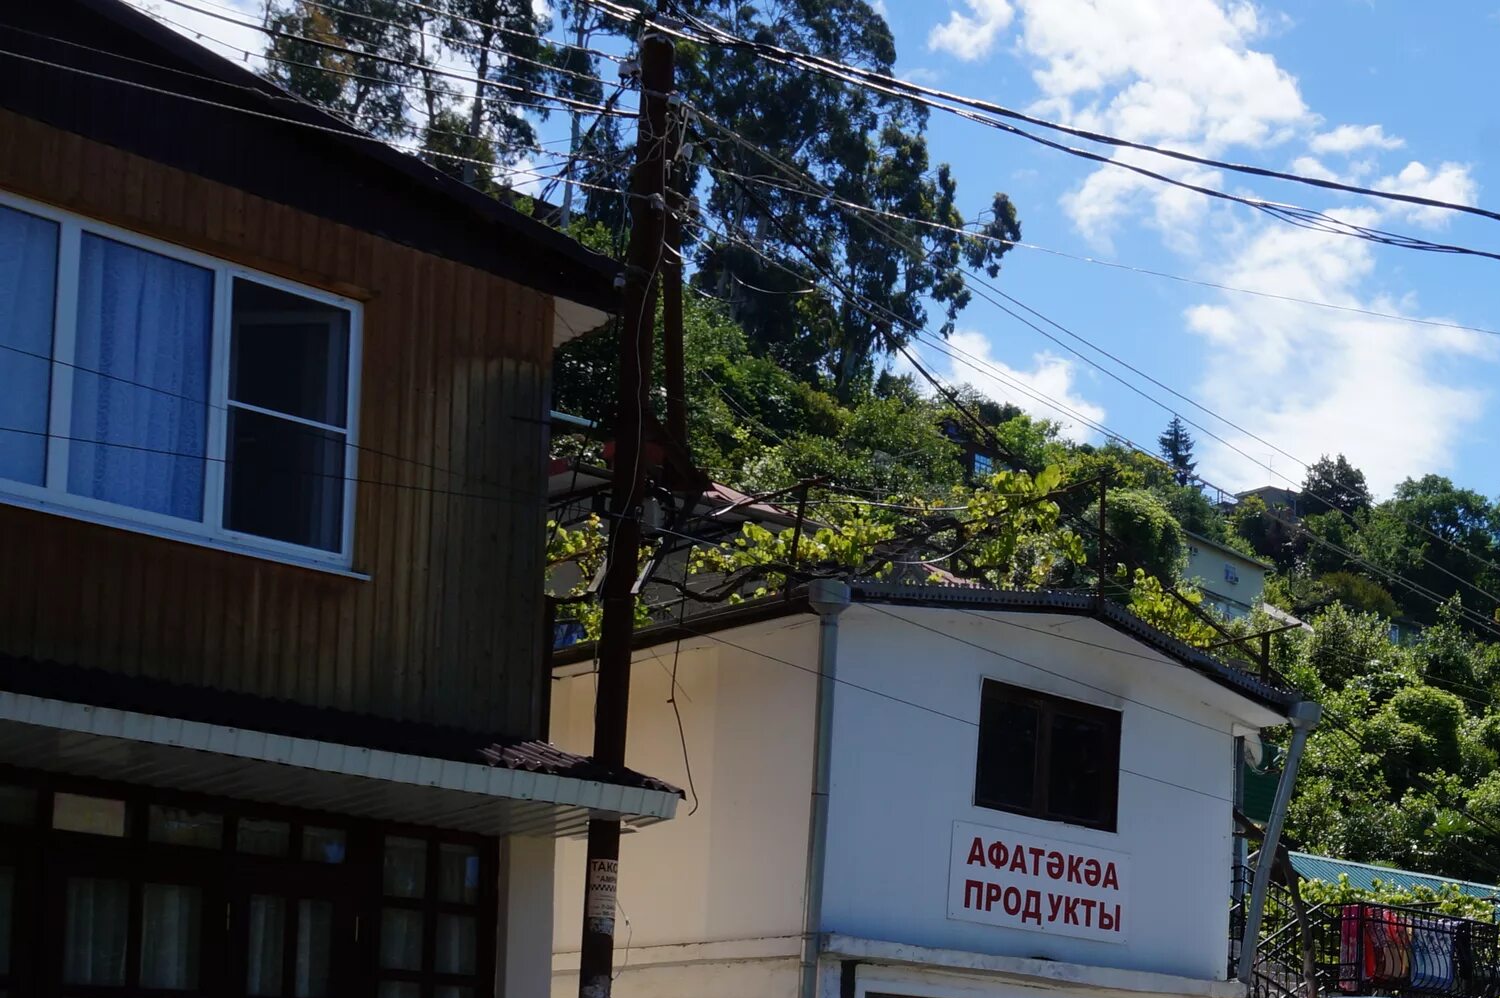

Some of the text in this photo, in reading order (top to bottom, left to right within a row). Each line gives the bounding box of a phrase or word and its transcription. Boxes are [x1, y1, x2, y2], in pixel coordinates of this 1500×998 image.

[591, 861, 618, 873] ТАКС
[966, 836, 1119, 890] АФАТӘКӘА
[963, 879, 1121, 932] ПРОДУКТЫ
